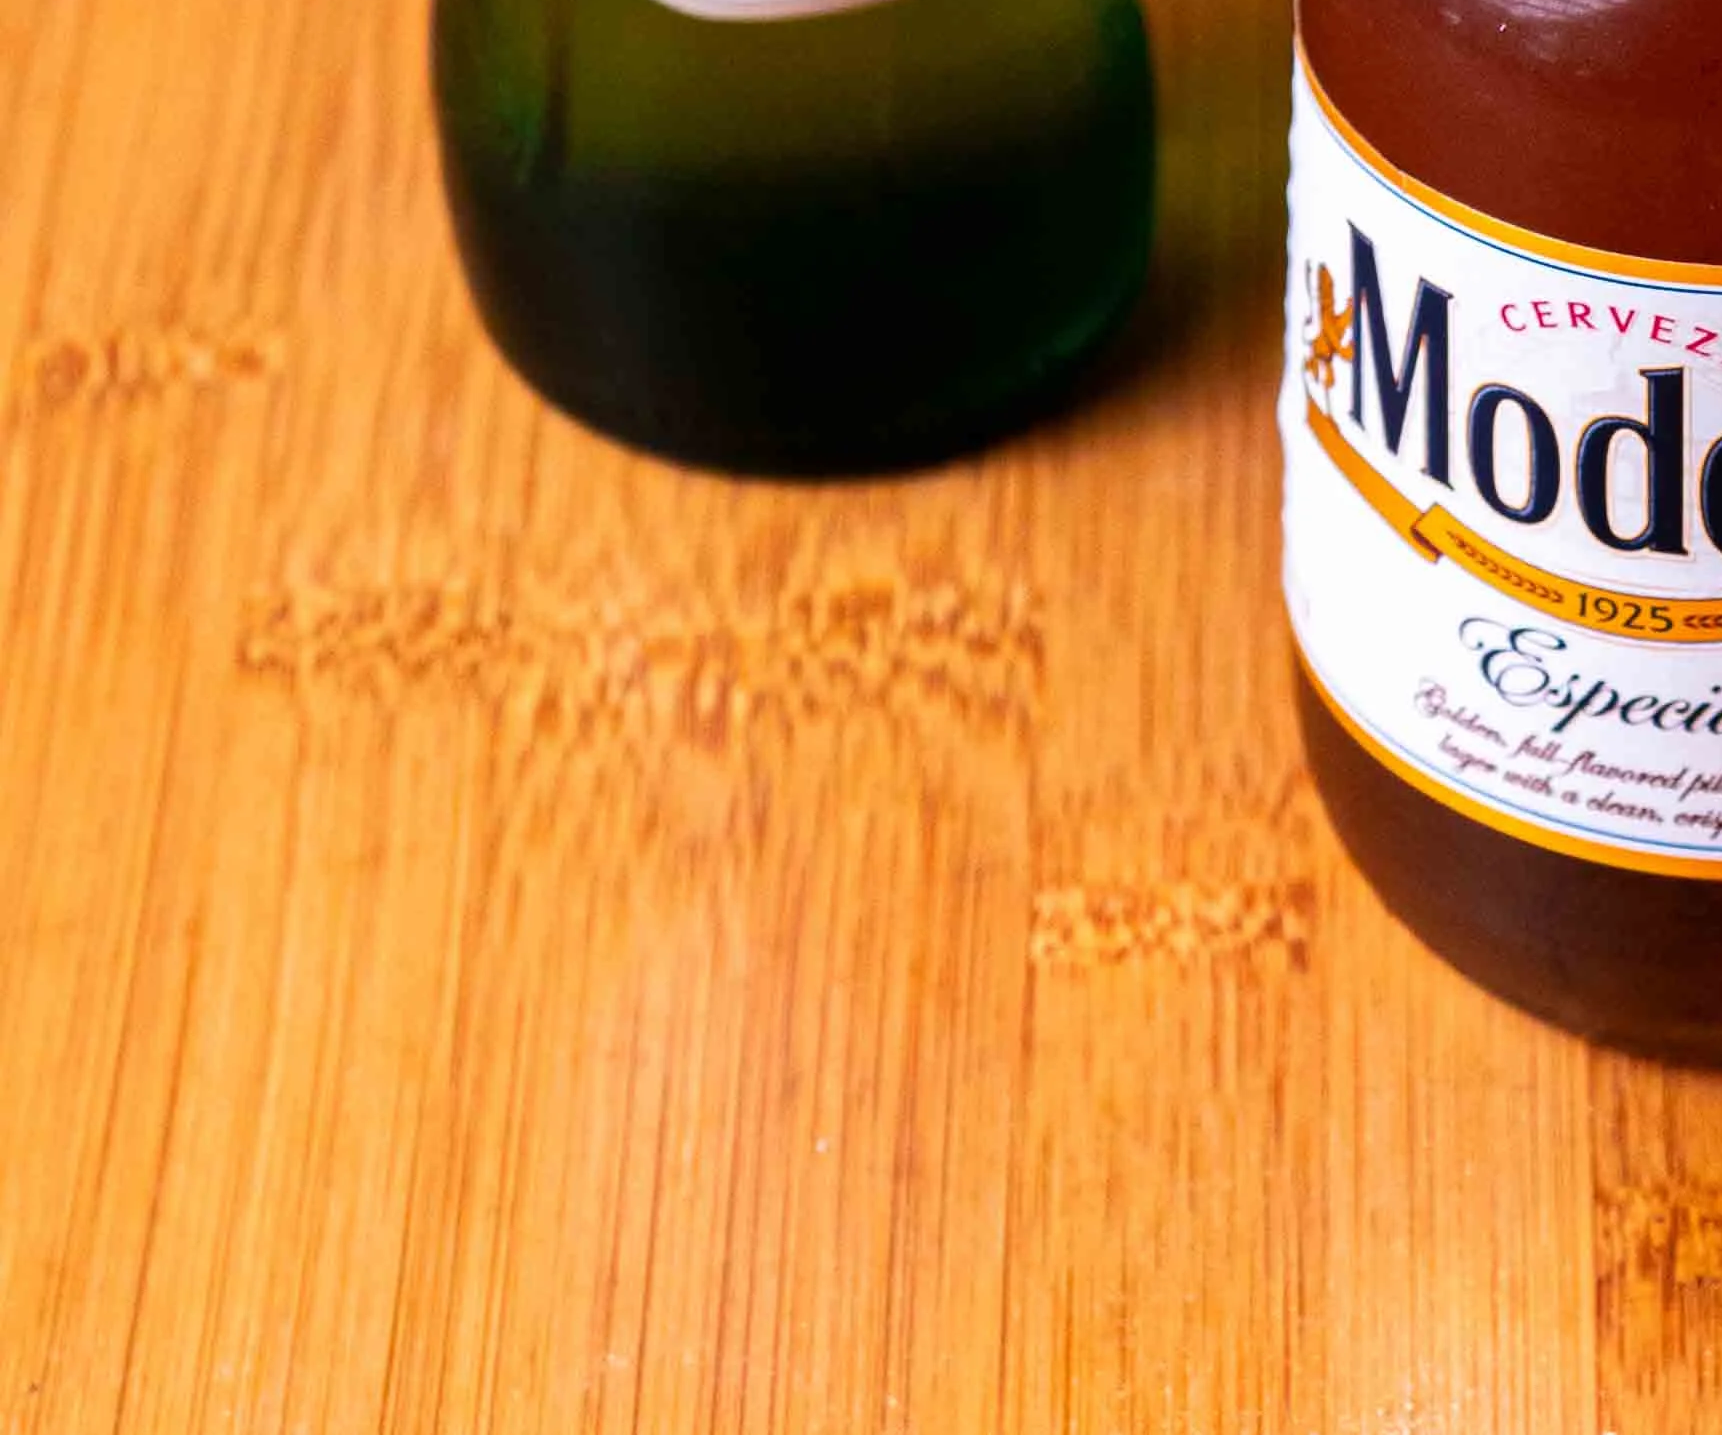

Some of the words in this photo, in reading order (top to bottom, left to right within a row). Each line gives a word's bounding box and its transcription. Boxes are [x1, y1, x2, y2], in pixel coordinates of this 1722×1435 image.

[1577, 590, 1674, 634] 1925
[1414, 676, 1508, 749] Golden,
[1514, 734, 1684, 795] full-flavored
[1438, 735, 1497, 775] lager
[1503, 766, 1554, 798] with
[1560, 787, 1579, 808] a
[1585, 784, 1664, 823] clean,
